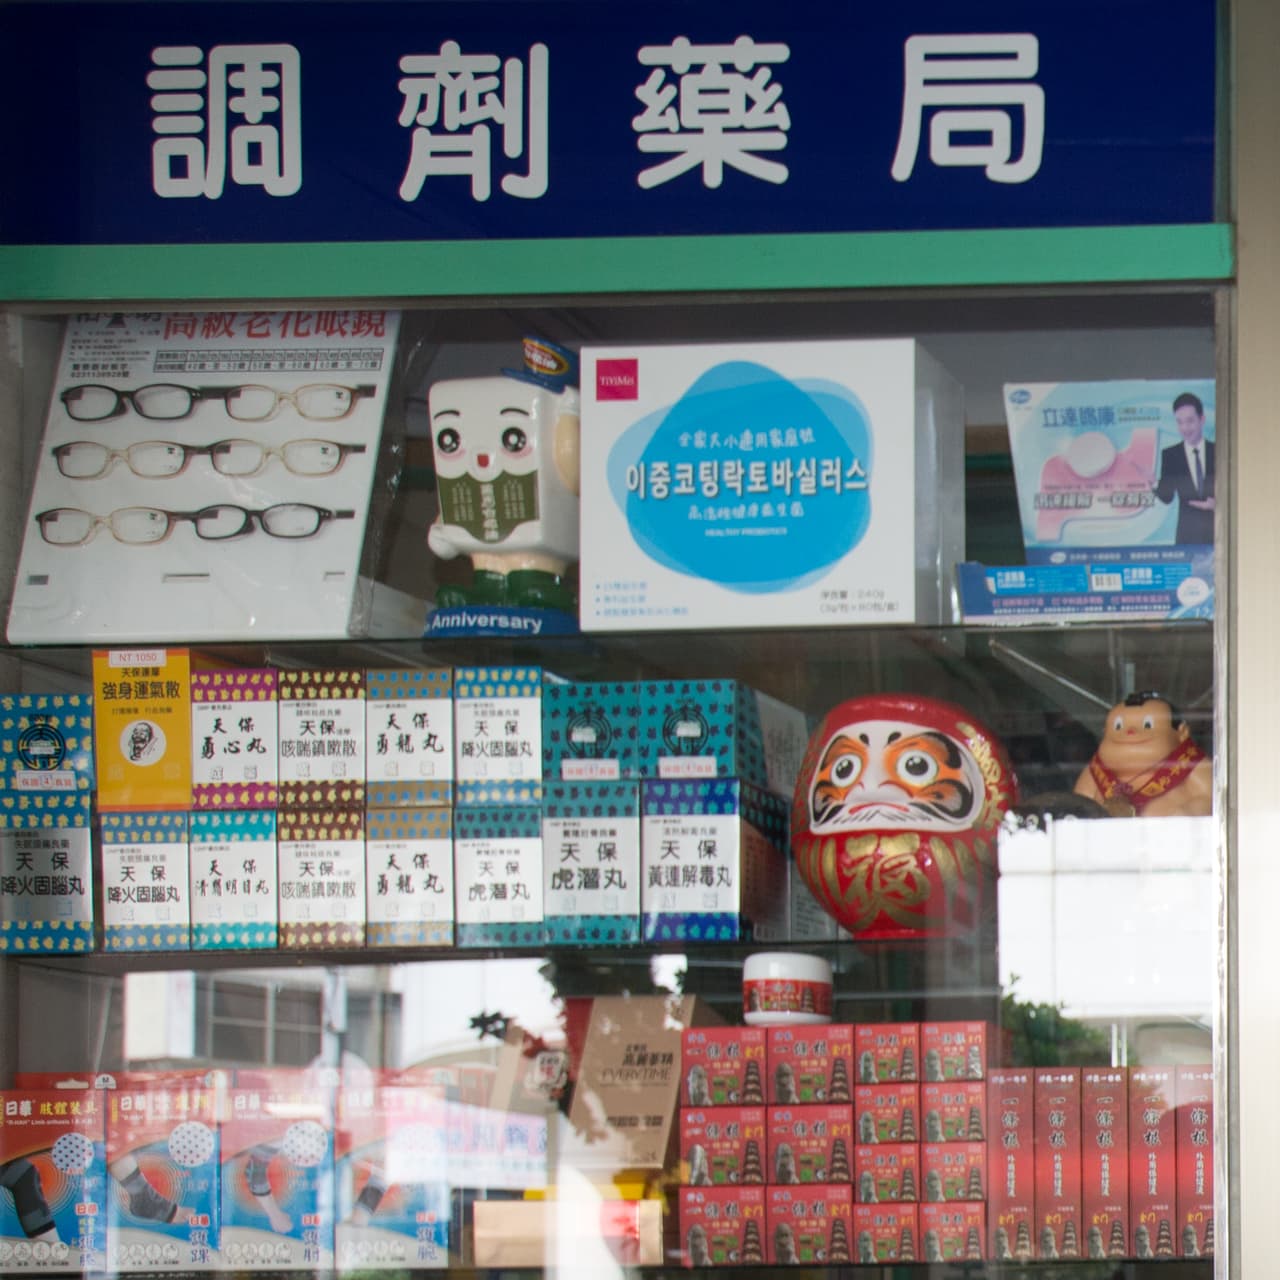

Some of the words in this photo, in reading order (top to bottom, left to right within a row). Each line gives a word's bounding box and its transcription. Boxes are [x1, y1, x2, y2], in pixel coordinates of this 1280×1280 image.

[146, 34, 1046, 203] 調劑藥局
[163, 310, 387, 341] 高級老化眼鏡
[625, 457, 869, 498] 이중코팅락토바실러스
[432, 611, 543, 634] Anniversary
[119, 653, 132, 662] NT
[135, 652, 157, 662] 1050
[102, 681, 181, 701] 強身運氣散
[212, 718, 256, 735] 天保
[300, 720, 335, 736] 天保
[386, 712, 430, 731] 天保
[475, 720, 519, 736] 天保
[201, 737, 267, 760] 勇心丸
[376, 732, 445, 756] 勇龍丸
[461, 741, 533, 759] 降火固腦丸
[560, 842, 618, 863] 天保
[660, 839, 718, 860] 天保
[15, 852, 70, 871] 天保
[209, 859, 256, 876] 天保
[299, 860, 335, 876] 天保
[386, 853, 430, 870] 天保
[479, 861, 521, 877] 天保
[120, 866, 166, 882] 天保
[551, 867, 627, 890] 虎潛丸
[648, 864, 733, 888] 黃連解毒丸
[1, 875, 85, 897] 降火固腦丸
[376, 873, 445, 896] 勇龍丸
[107, 886, 181, 904] 降火固腦丸
